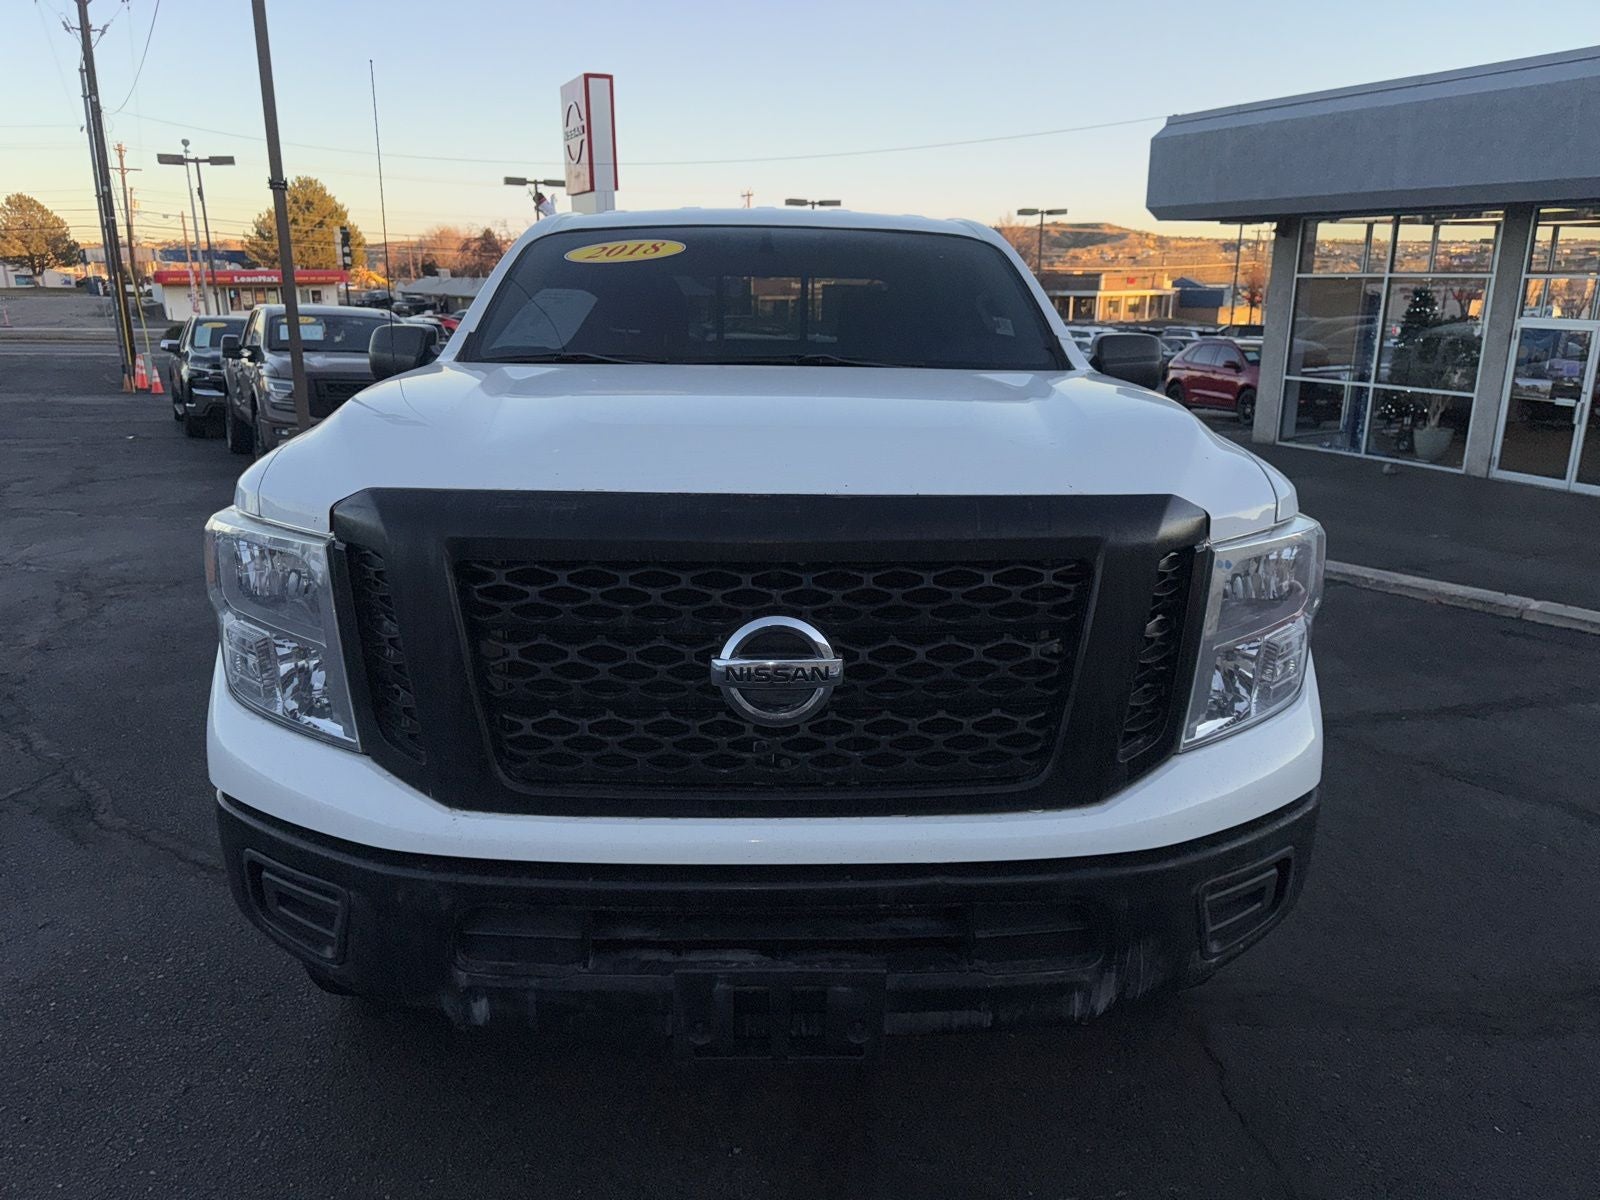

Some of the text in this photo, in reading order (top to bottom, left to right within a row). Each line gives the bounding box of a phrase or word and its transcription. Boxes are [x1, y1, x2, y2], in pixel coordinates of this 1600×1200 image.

[585, 242, 666, 259] 2018
[234, 275, 279, 283] LoanMax
[725, 666, 830, 682] NISSAN
